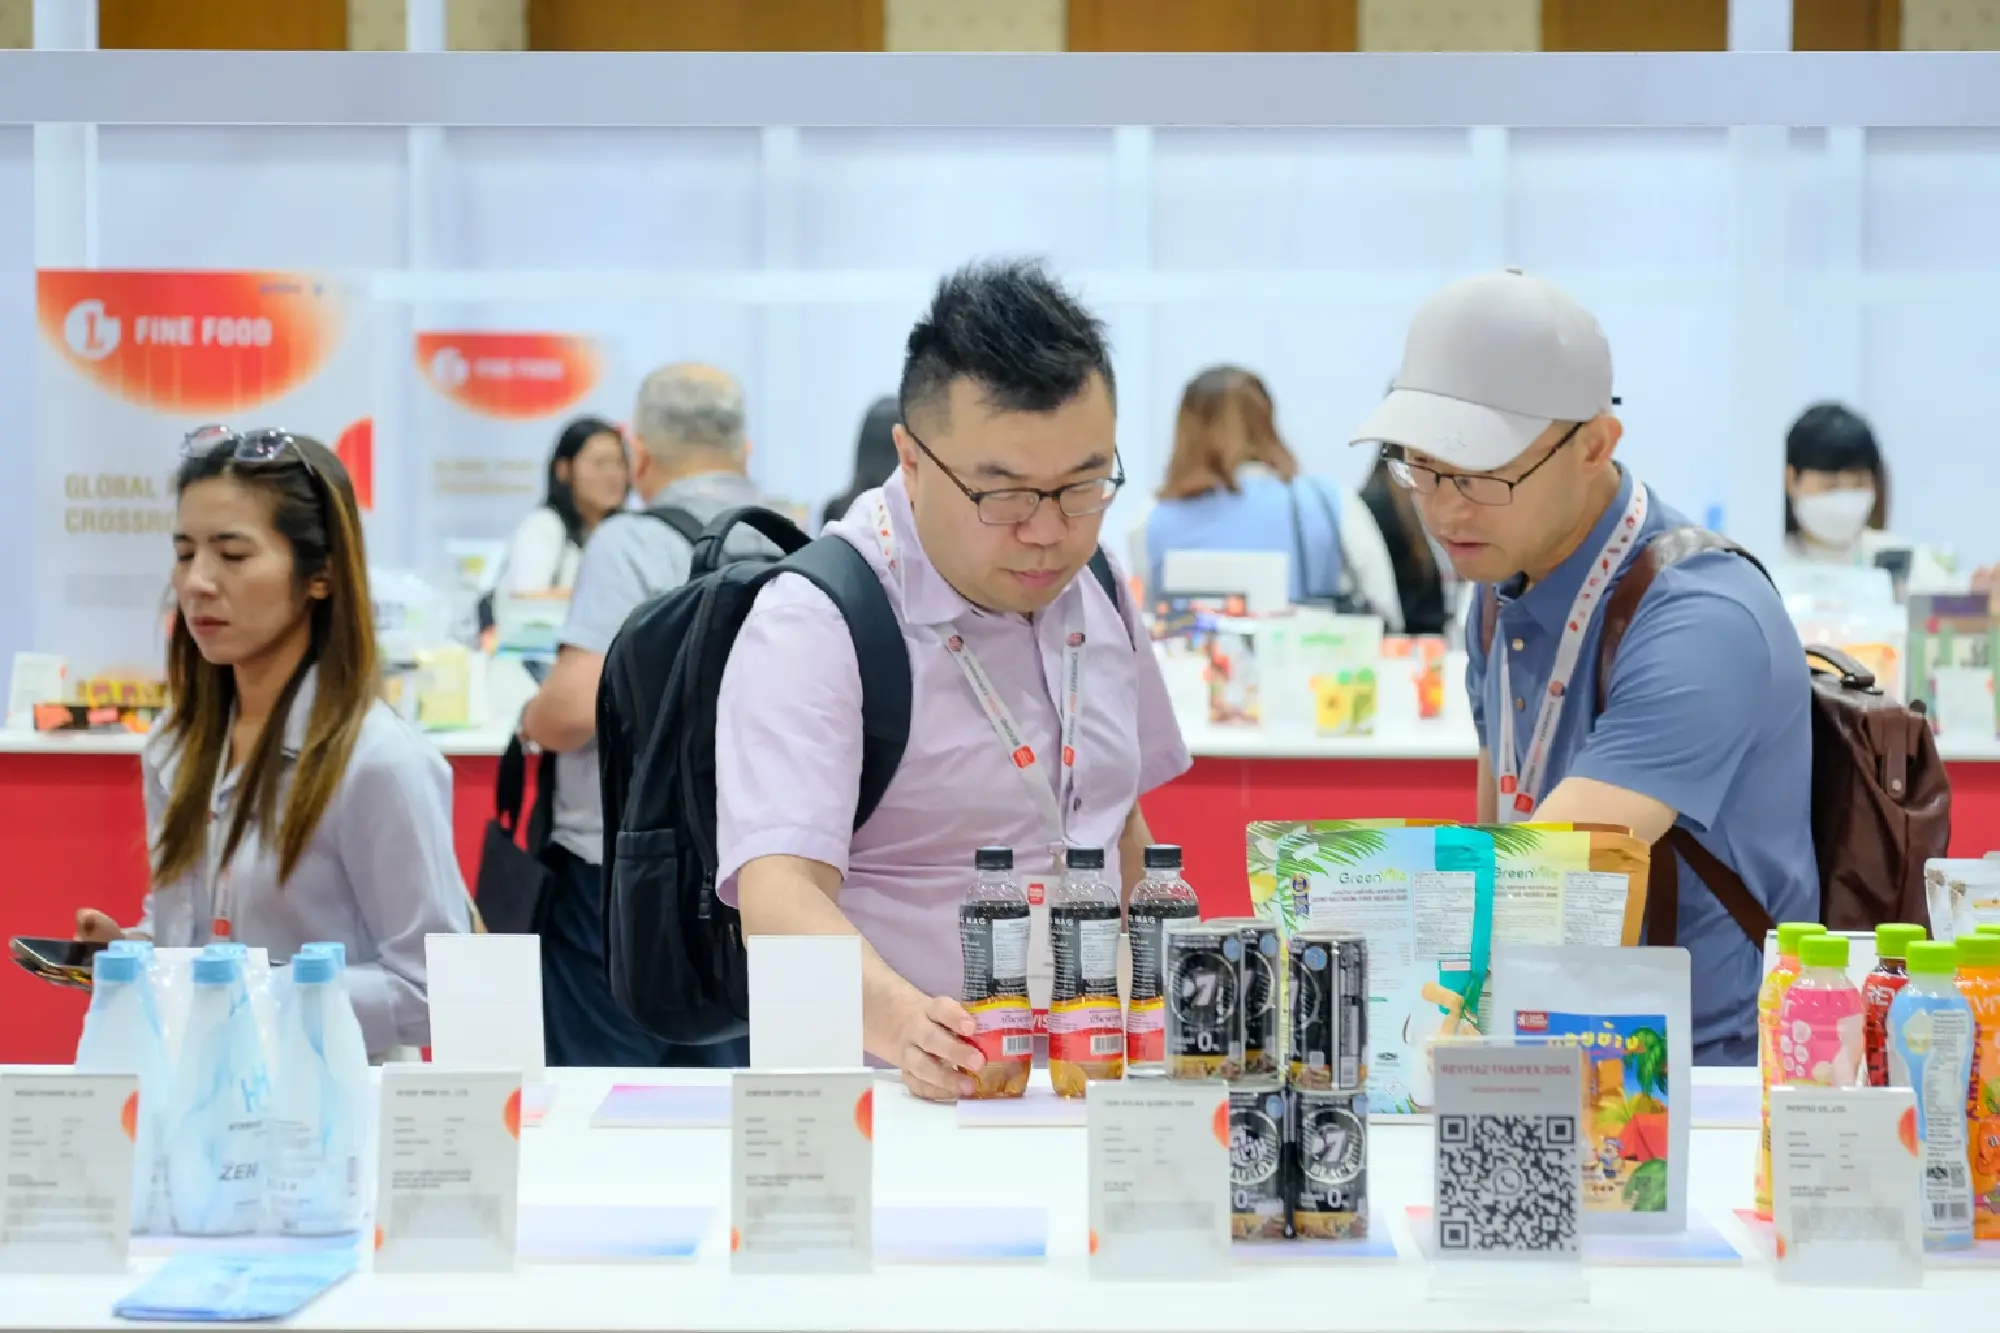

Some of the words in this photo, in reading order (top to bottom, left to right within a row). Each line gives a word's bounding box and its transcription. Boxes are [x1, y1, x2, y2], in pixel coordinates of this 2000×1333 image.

[134, 316, 194, 346] FINE
[202, 316, 273, 347] FOOD
[65, 474, 157, 500] GLOBAL
